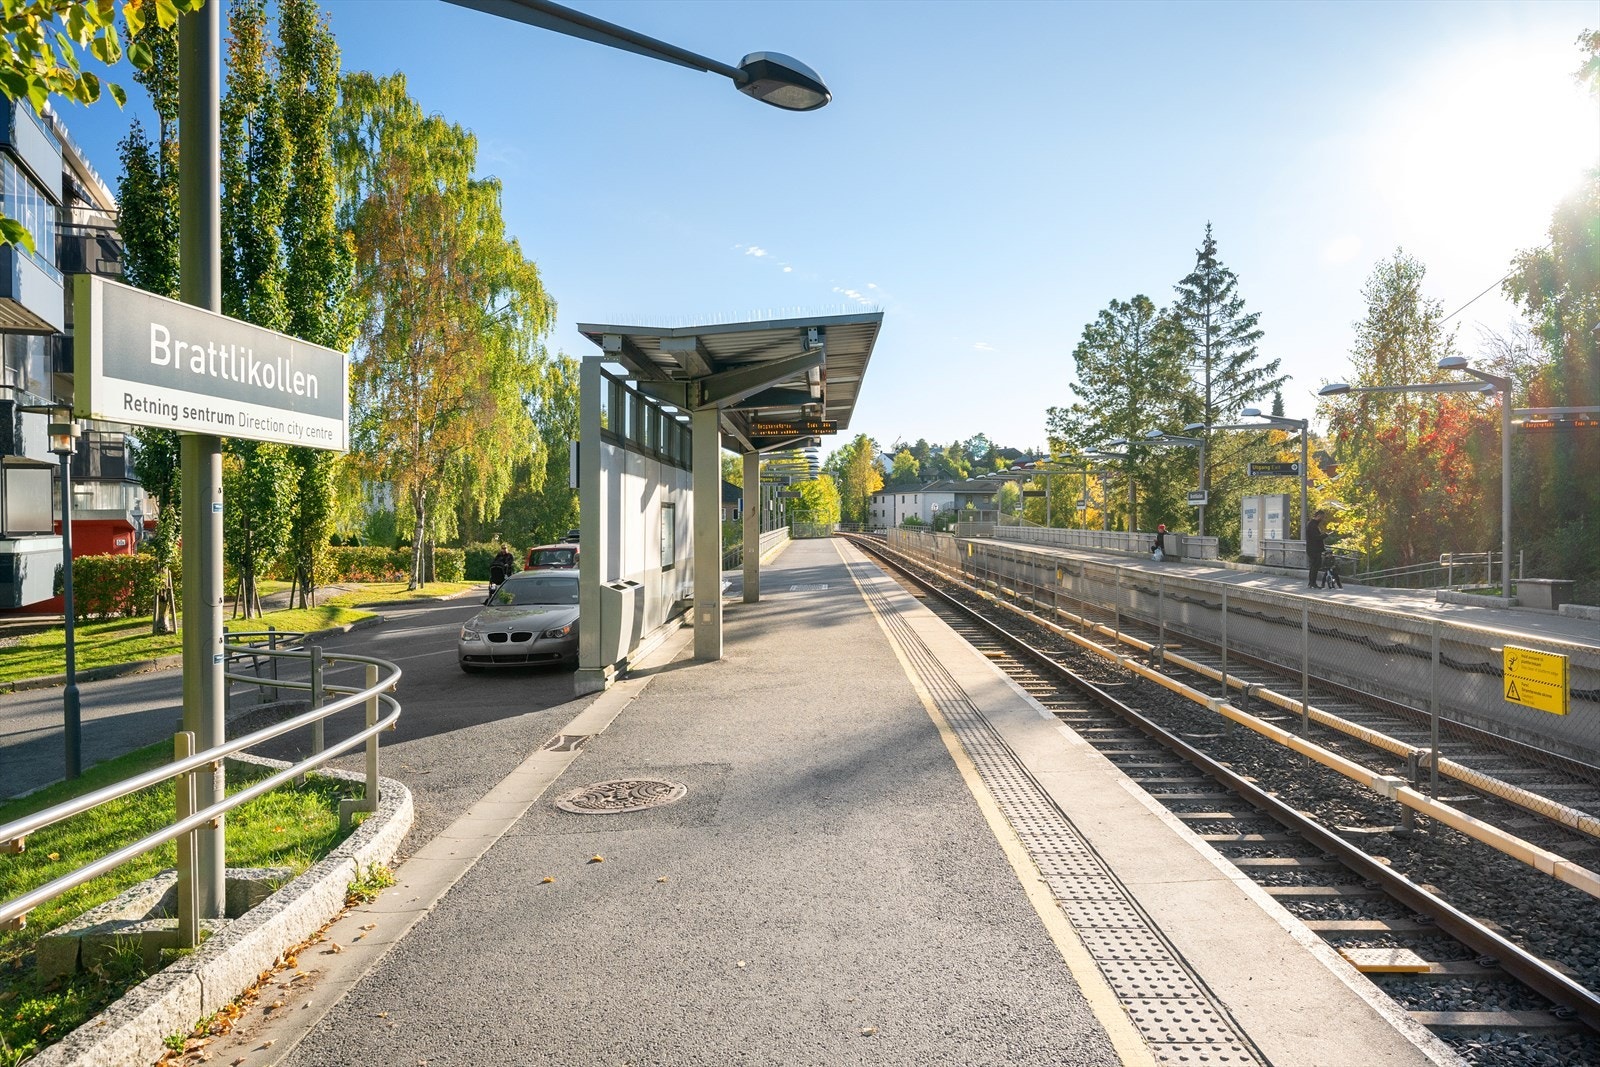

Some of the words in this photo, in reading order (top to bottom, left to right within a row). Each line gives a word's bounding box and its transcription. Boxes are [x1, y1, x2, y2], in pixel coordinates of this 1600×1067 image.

[150, 322, 318, 399] Brattlikollen
[123, 392, 179, 421] Retning
[183, 405, 235, 426] sentrum
[238, 412, 285, 433] Direction
[288, 421, 304, 440] city
[306, 426, 333, 440] centre
